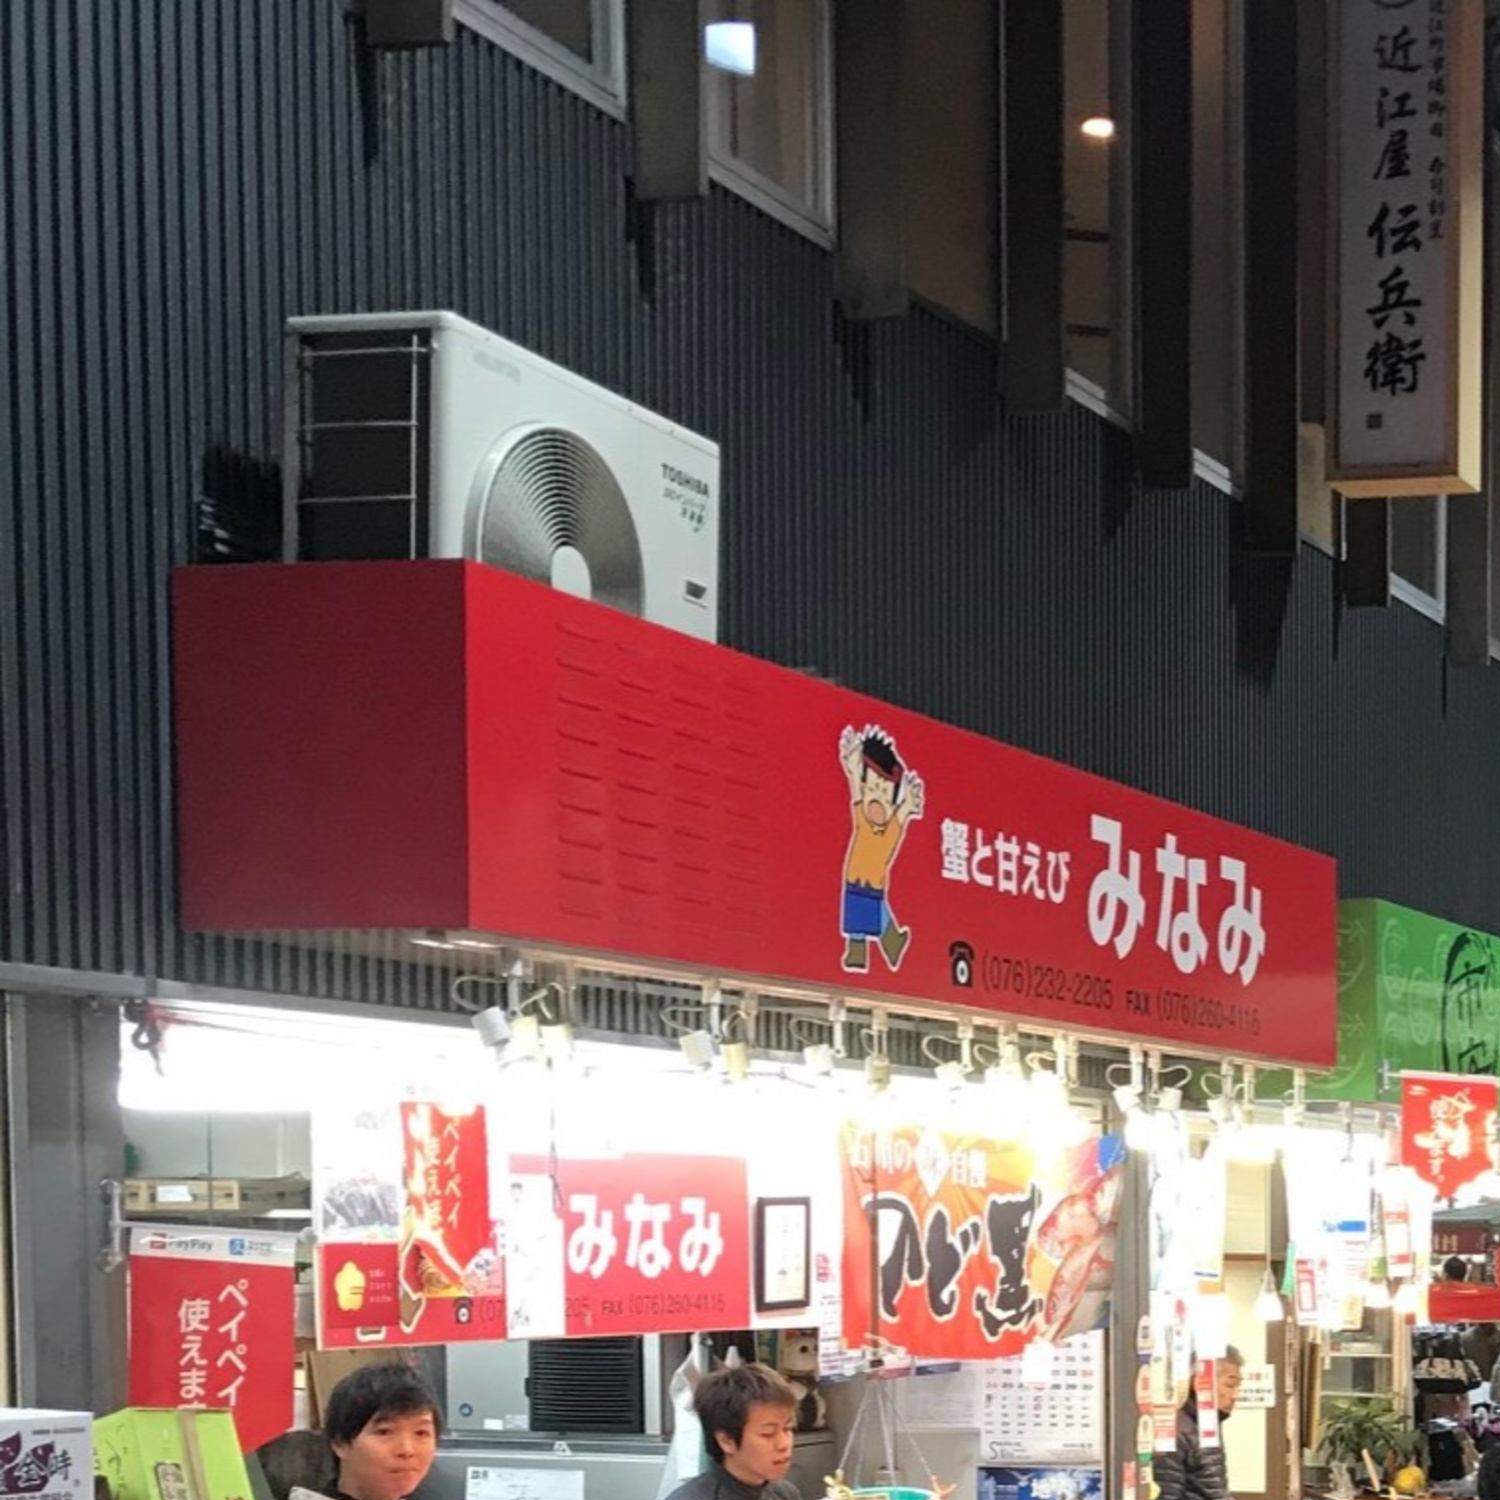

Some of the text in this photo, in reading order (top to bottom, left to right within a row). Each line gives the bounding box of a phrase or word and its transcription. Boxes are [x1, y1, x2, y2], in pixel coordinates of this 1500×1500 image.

[661, 463, 709, 496] TOSHIBA
[940, 817, 1071, 904] 蟹と甘えび
[1087, 813, 1266, 987] みなみ
[982, 950, 1113, 1010] (076)232-2205
[1126, 989, 1152, 1017] FAX
[566, 1193, 724, 1279] みなみ
[176, 1298, 212, 1409] 使えま
[216, 1278, 250, 1408] ペイペイ
